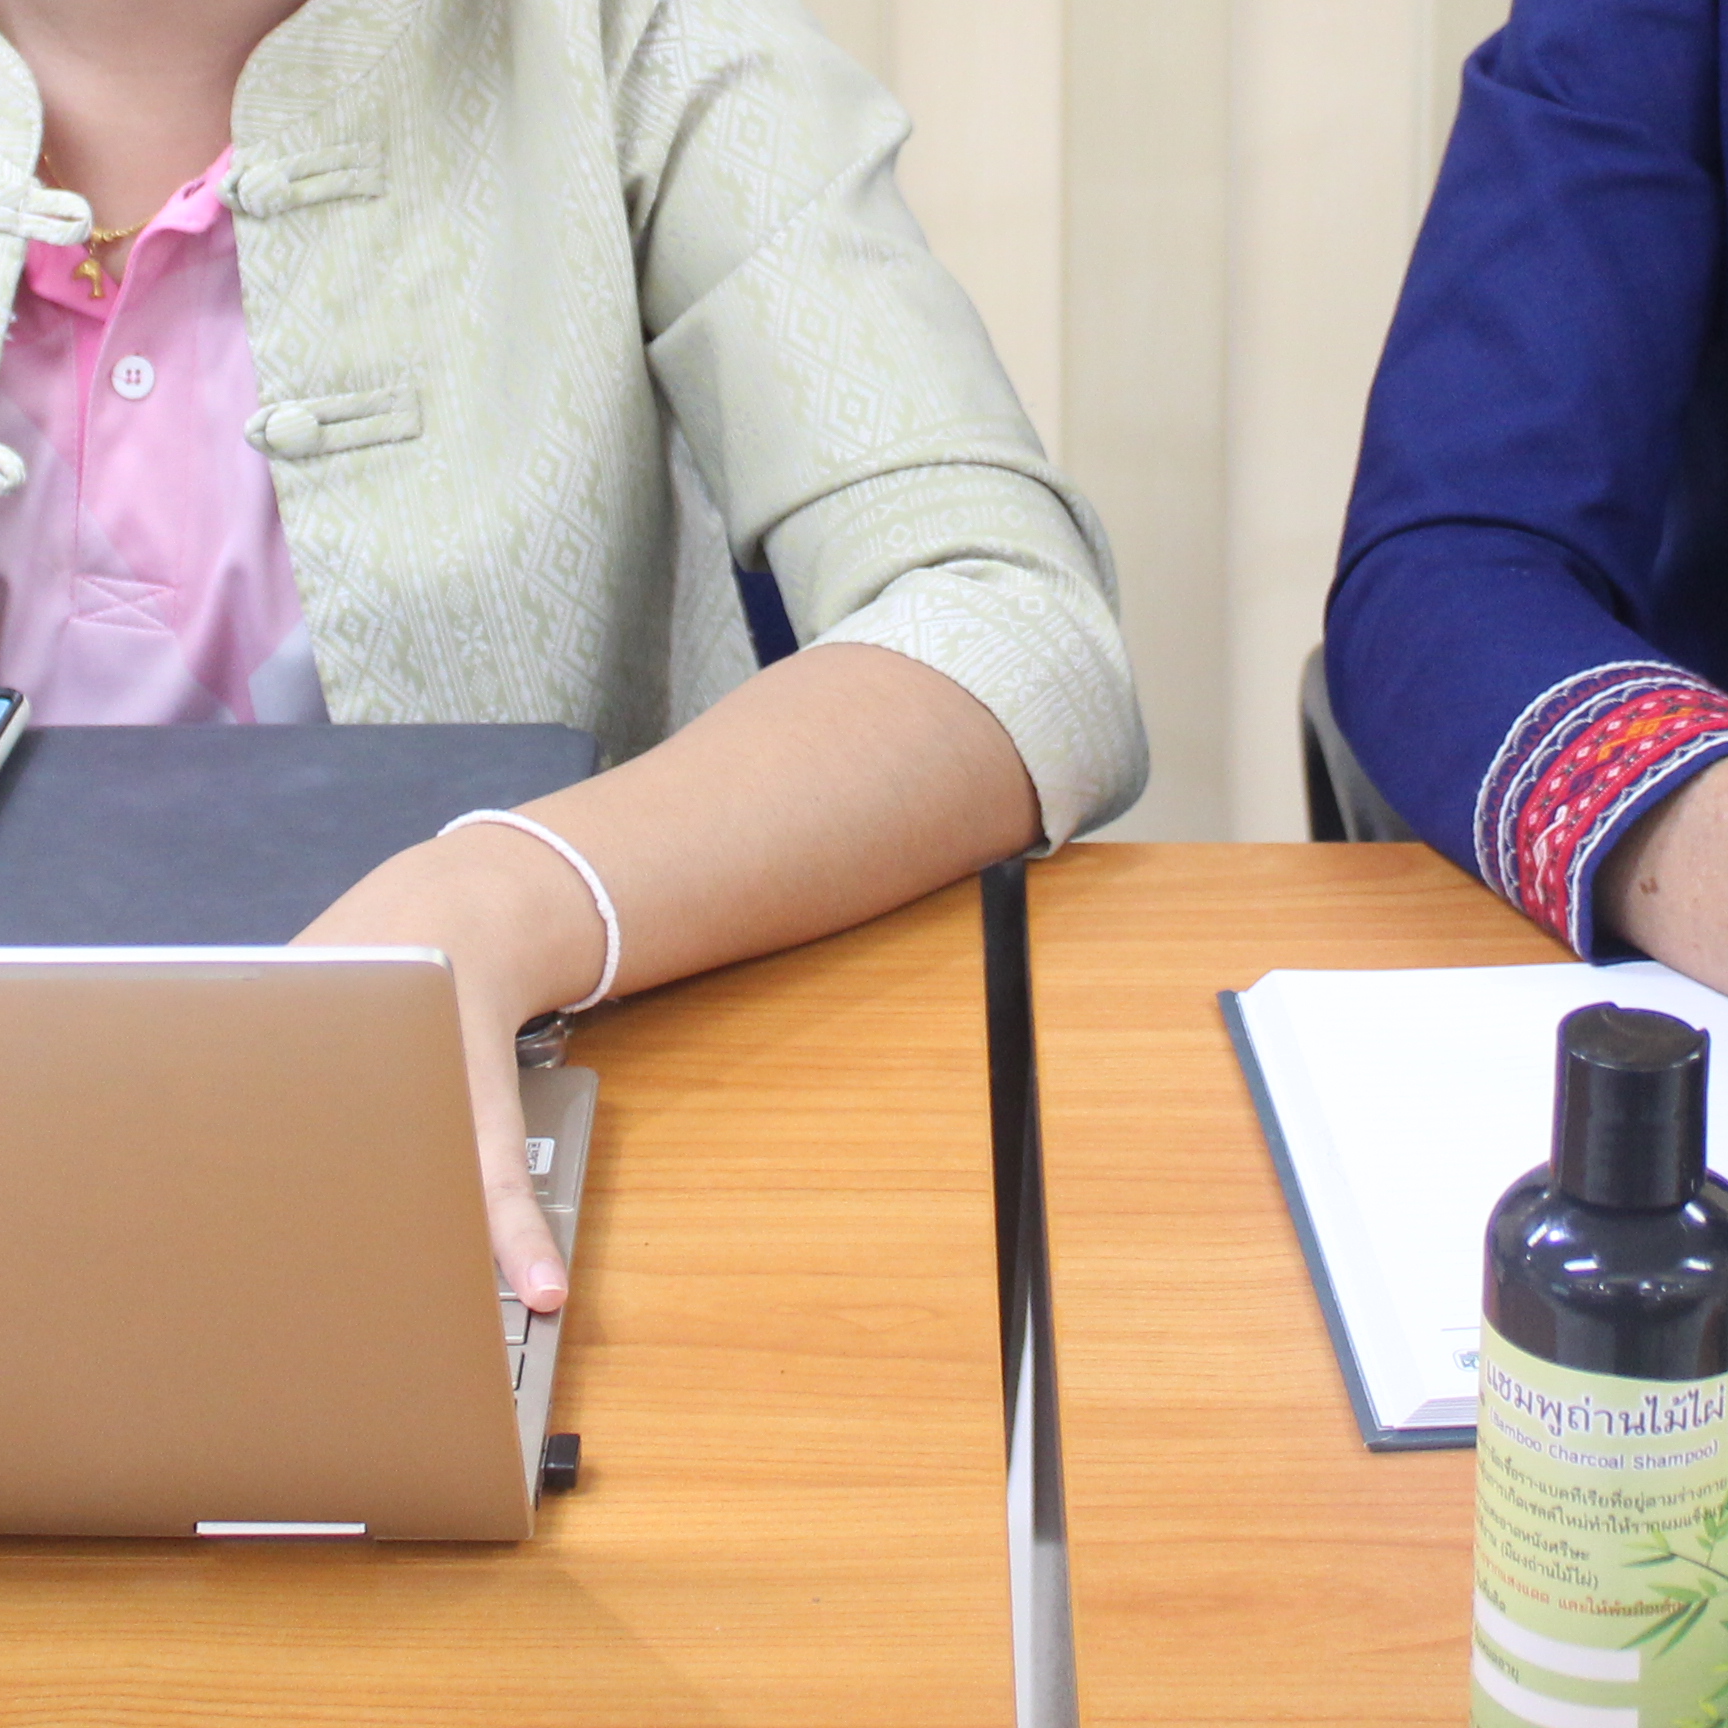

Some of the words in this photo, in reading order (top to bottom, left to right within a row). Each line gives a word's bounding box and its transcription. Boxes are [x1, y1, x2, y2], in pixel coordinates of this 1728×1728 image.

[1486, 1358, 1726, 1438] แชมพูถ่านไม้ไผ่
[1489, 1406, 1543, 1453] (Bamboo
[1548, 1443, 1625, 1470] Charcoal
[1632, 1438, 1720, 1471] Shampoo)
